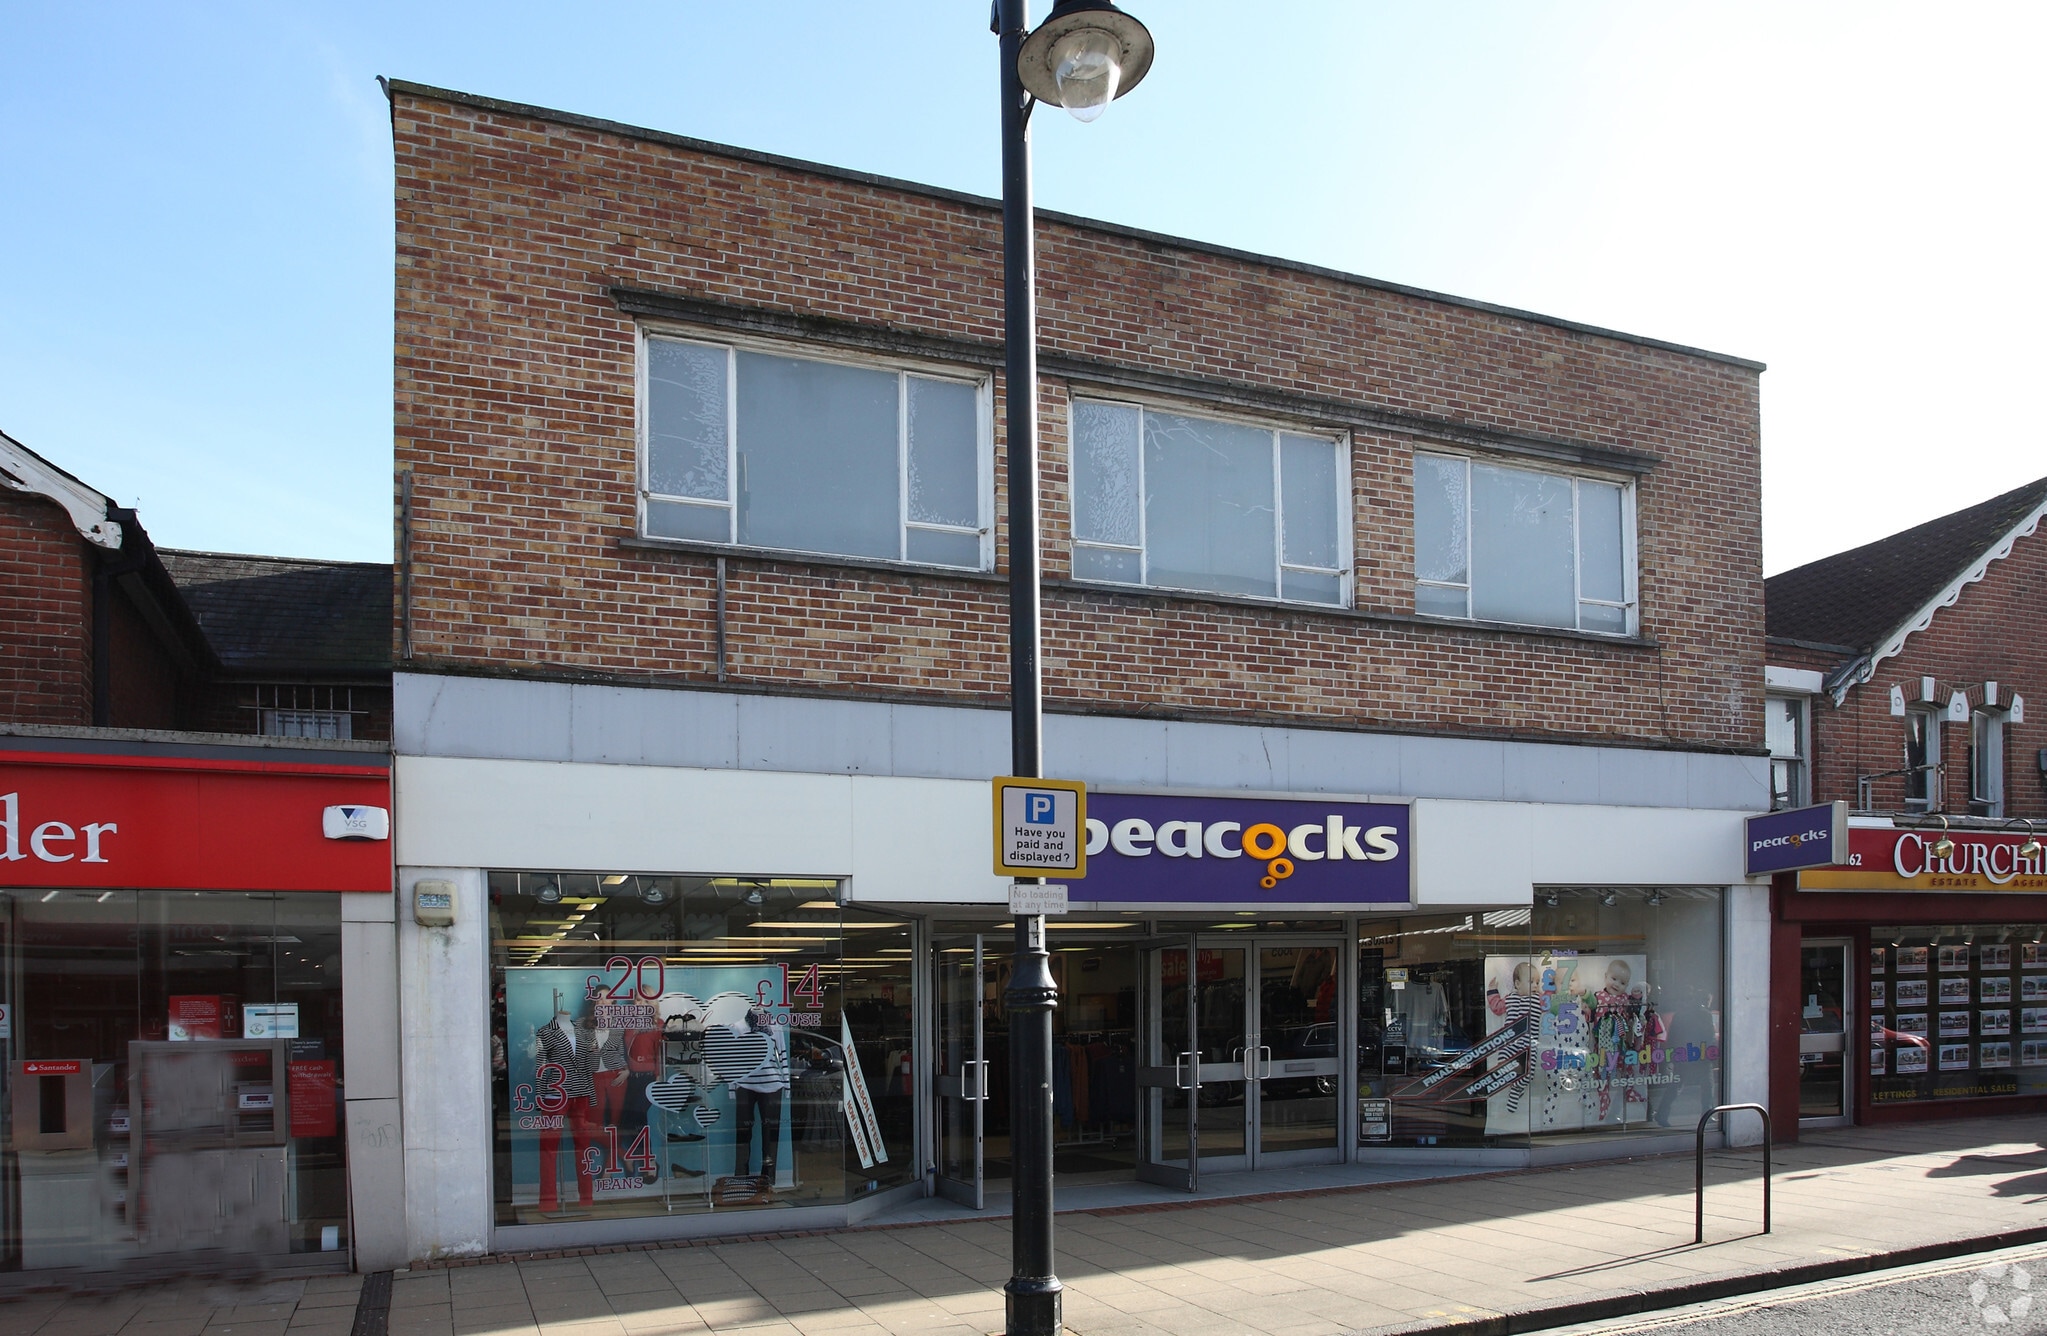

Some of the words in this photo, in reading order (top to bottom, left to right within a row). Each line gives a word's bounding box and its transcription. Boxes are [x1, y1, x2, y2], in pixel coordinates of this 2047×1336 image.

[1032, 797, 1051, 822] P
[344, 820, 367, 828] VSG
[1014, 826, 1043, 838] Have
[1046, 830, 1066, 841] you
[1753, 830, 1828, 852] peacocks
[1016, 839, 1040, 851] paid
[1043, 841, 1064, 851] and
[1931, 878, 1977, 887] ESTATE
[1013, 890, 1028, 899] No
[1030, 890, 1064, 901] loading
[1012, 901, 1022, 909] at
[1024, 901, 1042, 912] any
[1044, 901, 1065, 909] time
[1540, 950, 1552, 967] 2
[1551, 949, 1579, 958] Packs
[584, 956, 666, 1001] £20
[1541, 959, 1579, 992] £7
[755, 962, 825, 1009] £14
[594, 1004, 656, 1018] STRIPED
[1540, 993, 1551, 1011] 3
[597, 1016, 654, 1029] BLAZER
[757, 1013, 822, 1027] BLOUSE
[1540, 1002, 1579, 1036] £5
[1422, 1066, 1454, 1088] FINAL
[1452, 1029, 1516, 1069] REDUCTIONS
[1541, 1049, 1620, 1072] Simply
[1624, 1041, 1720, 1065] adorable
[39, 1063, 77, 1072] Santander
[1466, 1075, 1495, 1096] MORE
[1492, 1060, 1520, 1079] LINES
[1486, 1070, 1518, 1094] ADDED
[1610, 1072, 1681, 1087] essentials
[513, 1062, 569, 1113] £3
[1873, 1090, 1918, 1100] LETTINGS
[1933, 1086, 1990, 1097] RESIDENTIAL
[1991, 1083, 2018, 1093] SALES
[847, 1044, 857, 1070] NEW
[853, 1071, 870, 1112] SEASON
[867, 1113, 881, 1153] OFFERS
[519, 1115, 565, 1130] CAMI
[847, 1099, 856, 1122] NOW
[856, 1131, 868, 1161] STORE
[582, 1125, 657, 1176] £14
[595, 1177, 644, 1193] JEANS
